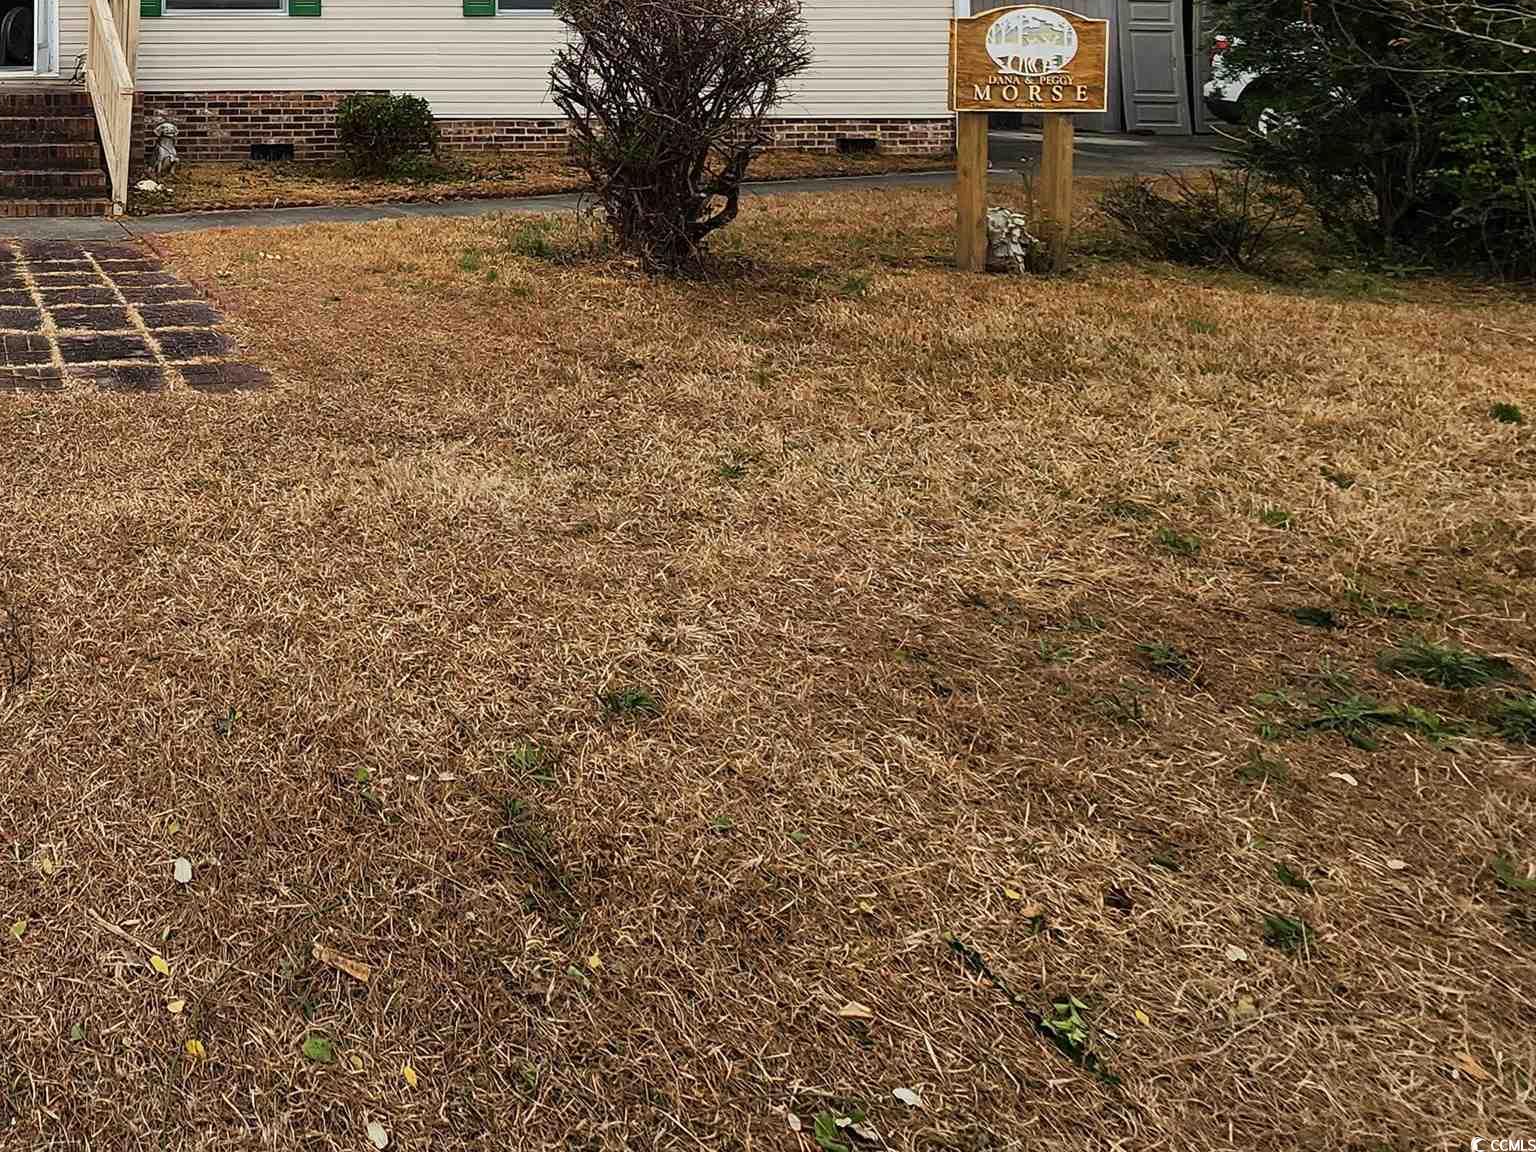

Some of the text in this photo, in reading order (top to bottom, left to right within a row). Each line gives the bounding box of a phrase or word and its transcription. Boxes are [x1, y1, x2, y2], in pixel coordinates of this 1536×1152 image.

[988, 75, 1073, 85] DANA & PEGGY
[974, 85, 1088, 101] MORSE
